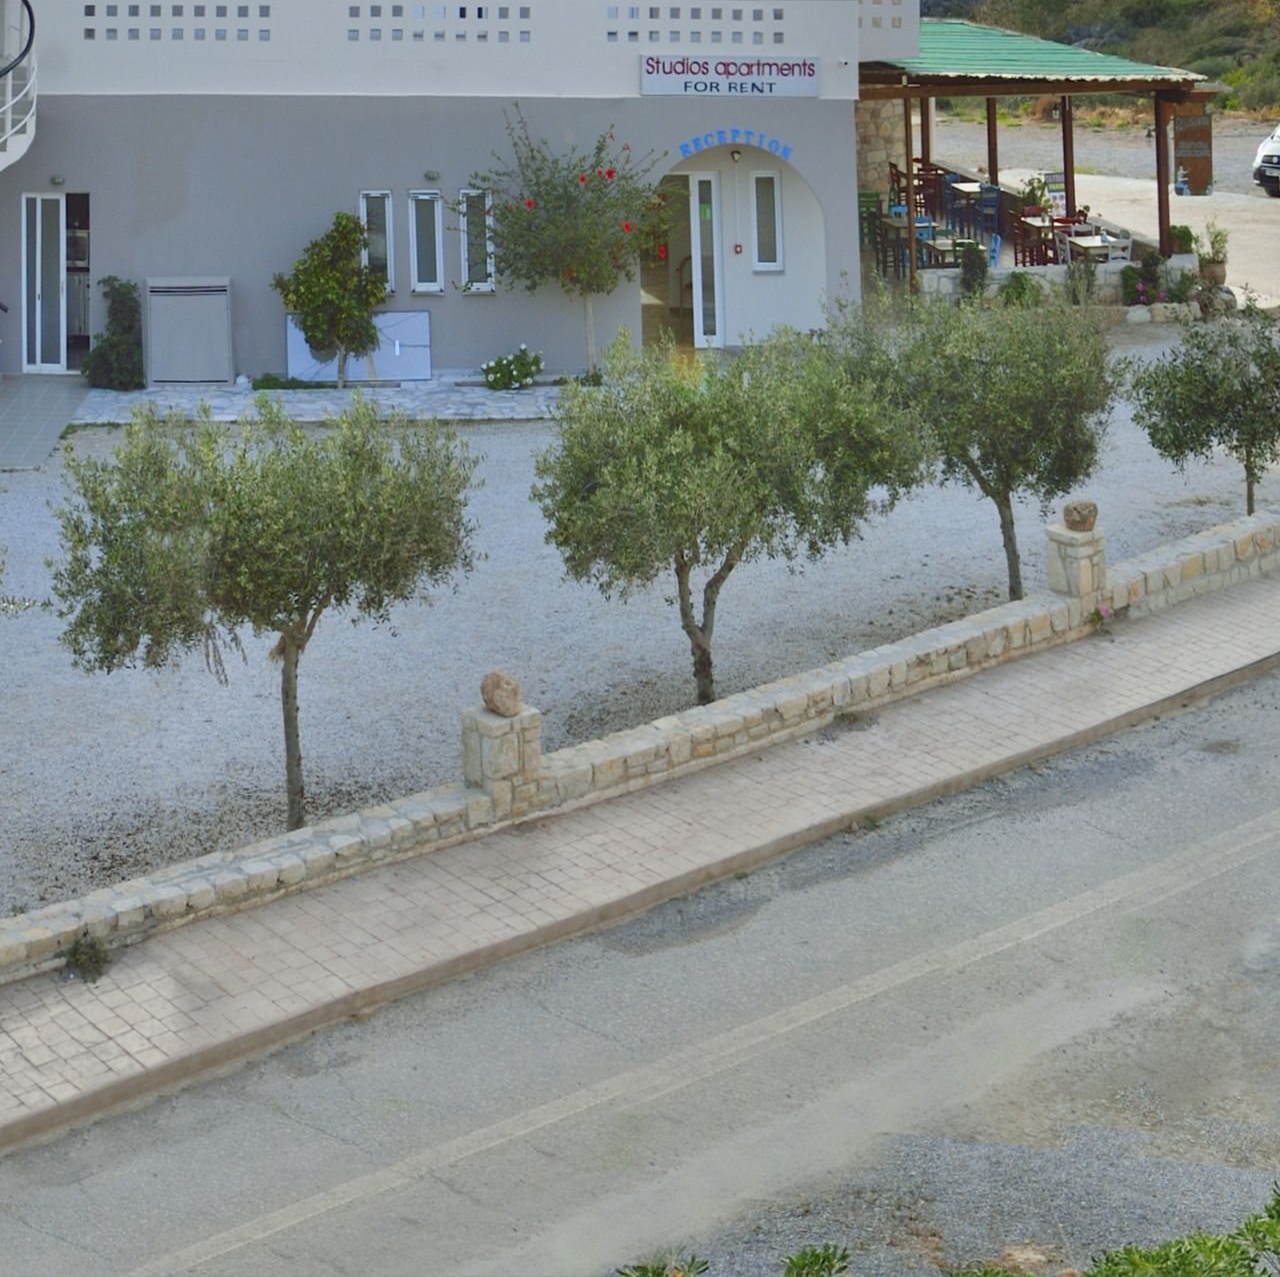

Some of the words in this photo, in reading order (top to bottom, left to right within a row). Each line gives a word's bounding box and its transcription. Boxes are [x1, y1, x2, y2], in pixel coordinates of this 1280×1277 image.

[646, 57, 710, 76] Studios
[714, 59, 816, 79] apartments
[683, 81, 720, 93] FOR
[728, 82, 777, 94] RENT
[678, 128, 793, 161] RECEPTION
